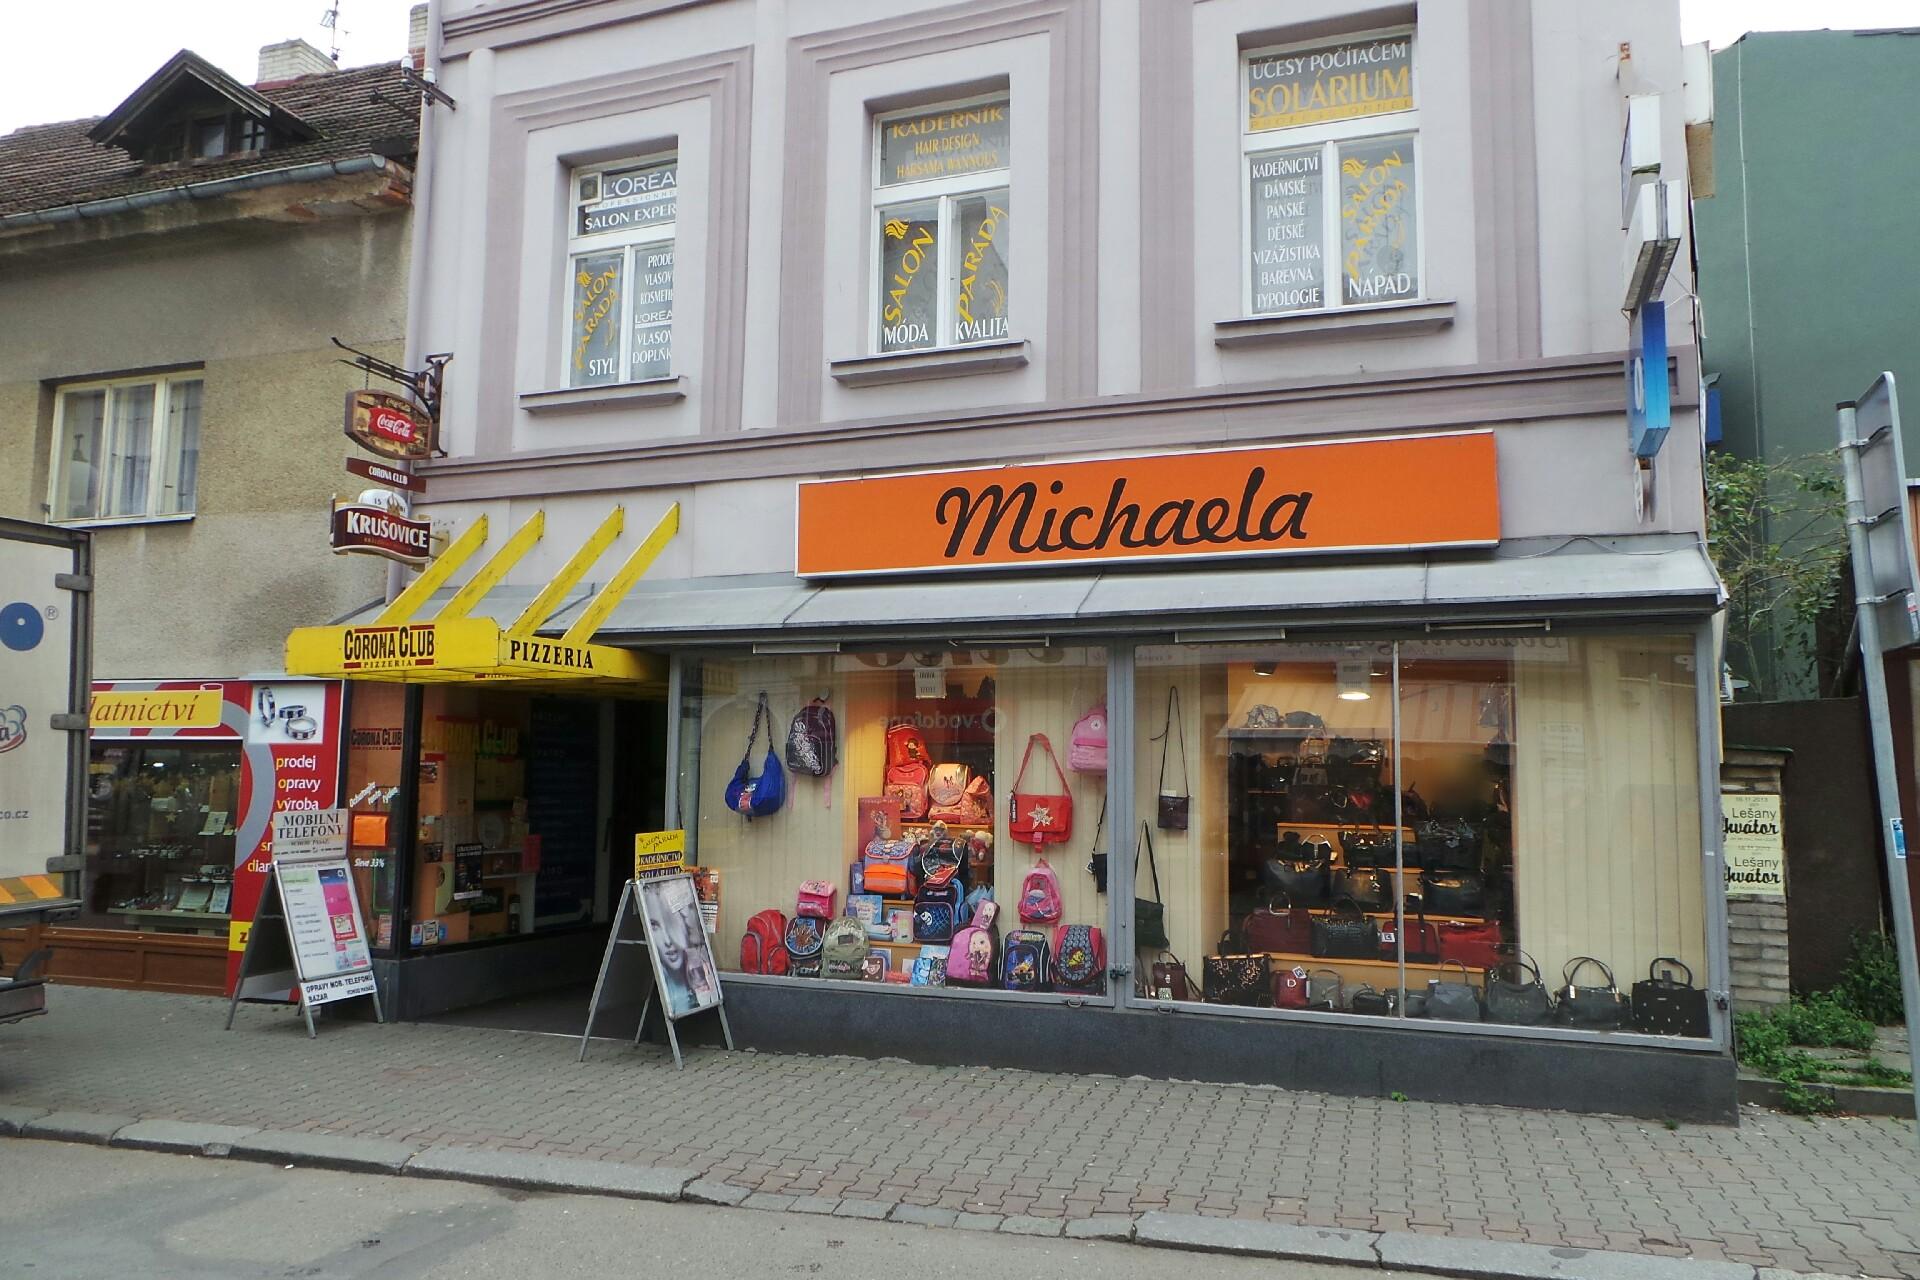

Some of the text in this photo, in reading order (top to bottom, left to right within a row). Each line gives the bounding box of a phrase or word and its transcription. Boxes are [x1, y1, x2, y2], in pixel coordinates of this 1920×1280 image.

[1252, 41, 1406, 80] ÚČESY POČÍTAČEM
[1250, 65, 1409, 118] SOLÁRIUM
[915, 132, 981, 156] HAIR DESIGN
[1252, 152, 1319, 179] KADEŘNICTVÍ
[1265, 175, 1307, 199] DÁMSKÉ
[586, 190, 676, 209] PROFESSIONNE
[1267, 197, 1305, 219] PÁNSKÉ
[584, 202, 676, 231] SALON EXPER
[1267, 219, 1304, 241] DĚTSKÉ
[648, 252, 674, 268] PRODE
[957, 205, 1009, 325] PARÁDA
[1253, 244, 1321, 265] VIZÁŽISTIKA
[645, 271, 673, 286] VLASOV
[884, 227, 934, 327] SALON
[1261, 264, 1314, 286] BAREVNÁ
[1349, 268, 1411, 298] NÁPAD
[1257, 287, 1320, 308] TYPOLOGIE
[883, 318, 929, 345] MÓDA
[955, 317, 1009, 341] KVALITA
[588, 358, 616, 377] STYL
[368, 465, 408, 485] CORONA CLUB
[936, 467, 1312, 558] Michaela
[346, 510, 429, 549] KRUŠOVICE
[344, 626, 435, 660] CORONA CLUB
[363, 659, 412, 669] PIZZERIA
[510, 639, 594, 670] PIZZERIA
[88, 694, 200, 721] latnictví
[351, 728, 402, 746] CORONA CLUB
[276, 755, 317, 771] prodej
[278, 777, 320, 793] opravy
[0, 809, 29, 820] co.cz
[277, 796, 319, 812] výroba
[1732, 807, 1777, 821] Lešany
[284, 812, 339, 826] MOBILNÍ
[1722, 818, 1779, 836] kvátor
[278, 825, 343, 839] TELEFONY
[370, 858, 385, 868] 33%
[640, 852, 681, 865] KADEŘNICTVÍ
[1734, 856, 1779, 870] Lešany
[306, 982, 329, 993] OPRAVY
[308, 992, 329, 1003] BAZAR
